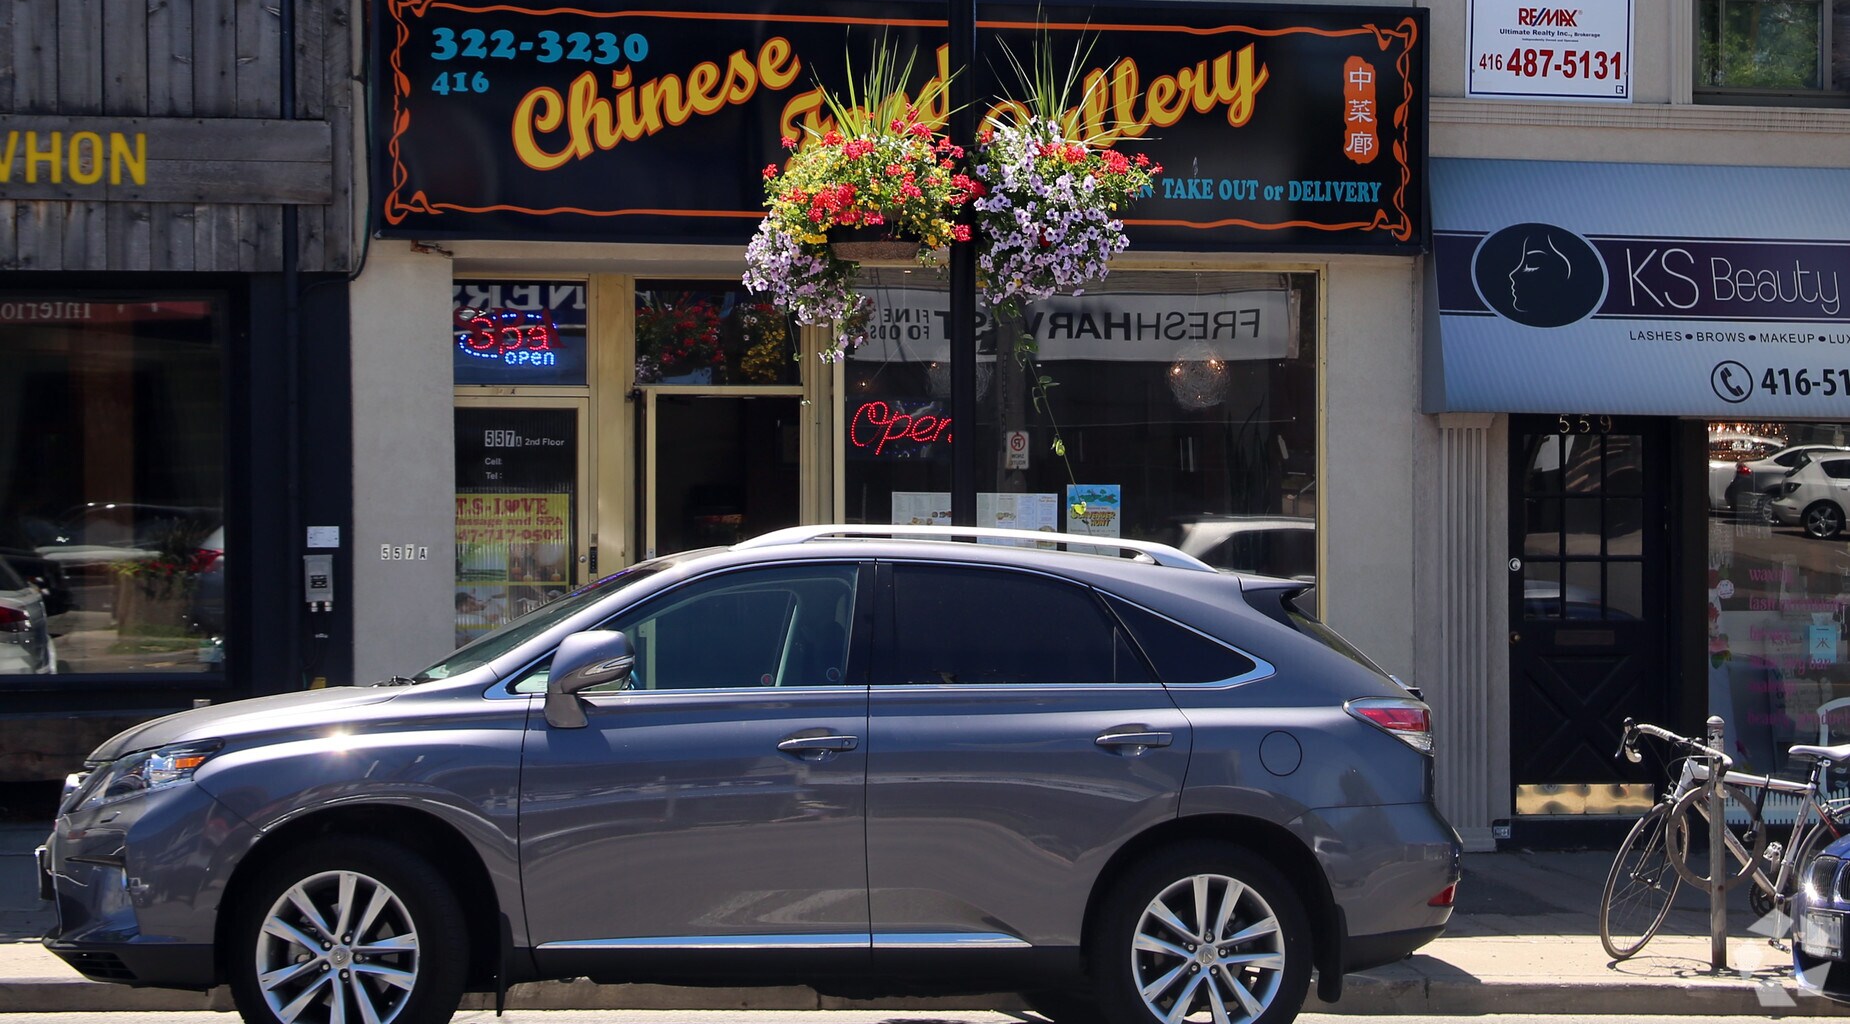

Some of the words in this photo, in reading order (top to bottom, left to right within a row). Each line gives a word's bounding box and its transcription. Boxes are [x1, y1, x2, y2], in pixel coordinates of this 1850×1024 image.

[1500, 28, 1531, 36] Ultimate
[430, 27, 649, 64] 322-3230
[1479, 53, 1503, 71] 416
[1506, 48, 1621, 80] 487-5131
[431, 70, 490, 95] 416
[512, 35, 802, 171] Chinese
[1345, 66, 1373, 156] 中菜廊
[1162, 178, 1214, 200] TAKE
[1218, 179, 1259, 200] OUT
[1263, 185, 1284, 201] or
[1288, 180, 1382, 202] DELIVERY
[1626, 247, 1700, 309] KS
[1710, 257, 1841, 315] Beauty
[1629, 330, 1682, 342] LASHES
[1696, 331, 1746, 343] BROWS
[1760, 332, 1815, 343] MAKEUP
[1559, 414, 1612, 433] 559
[524, 438, 540, 446] 2nd
[542, 438, 565, 446] Floor
